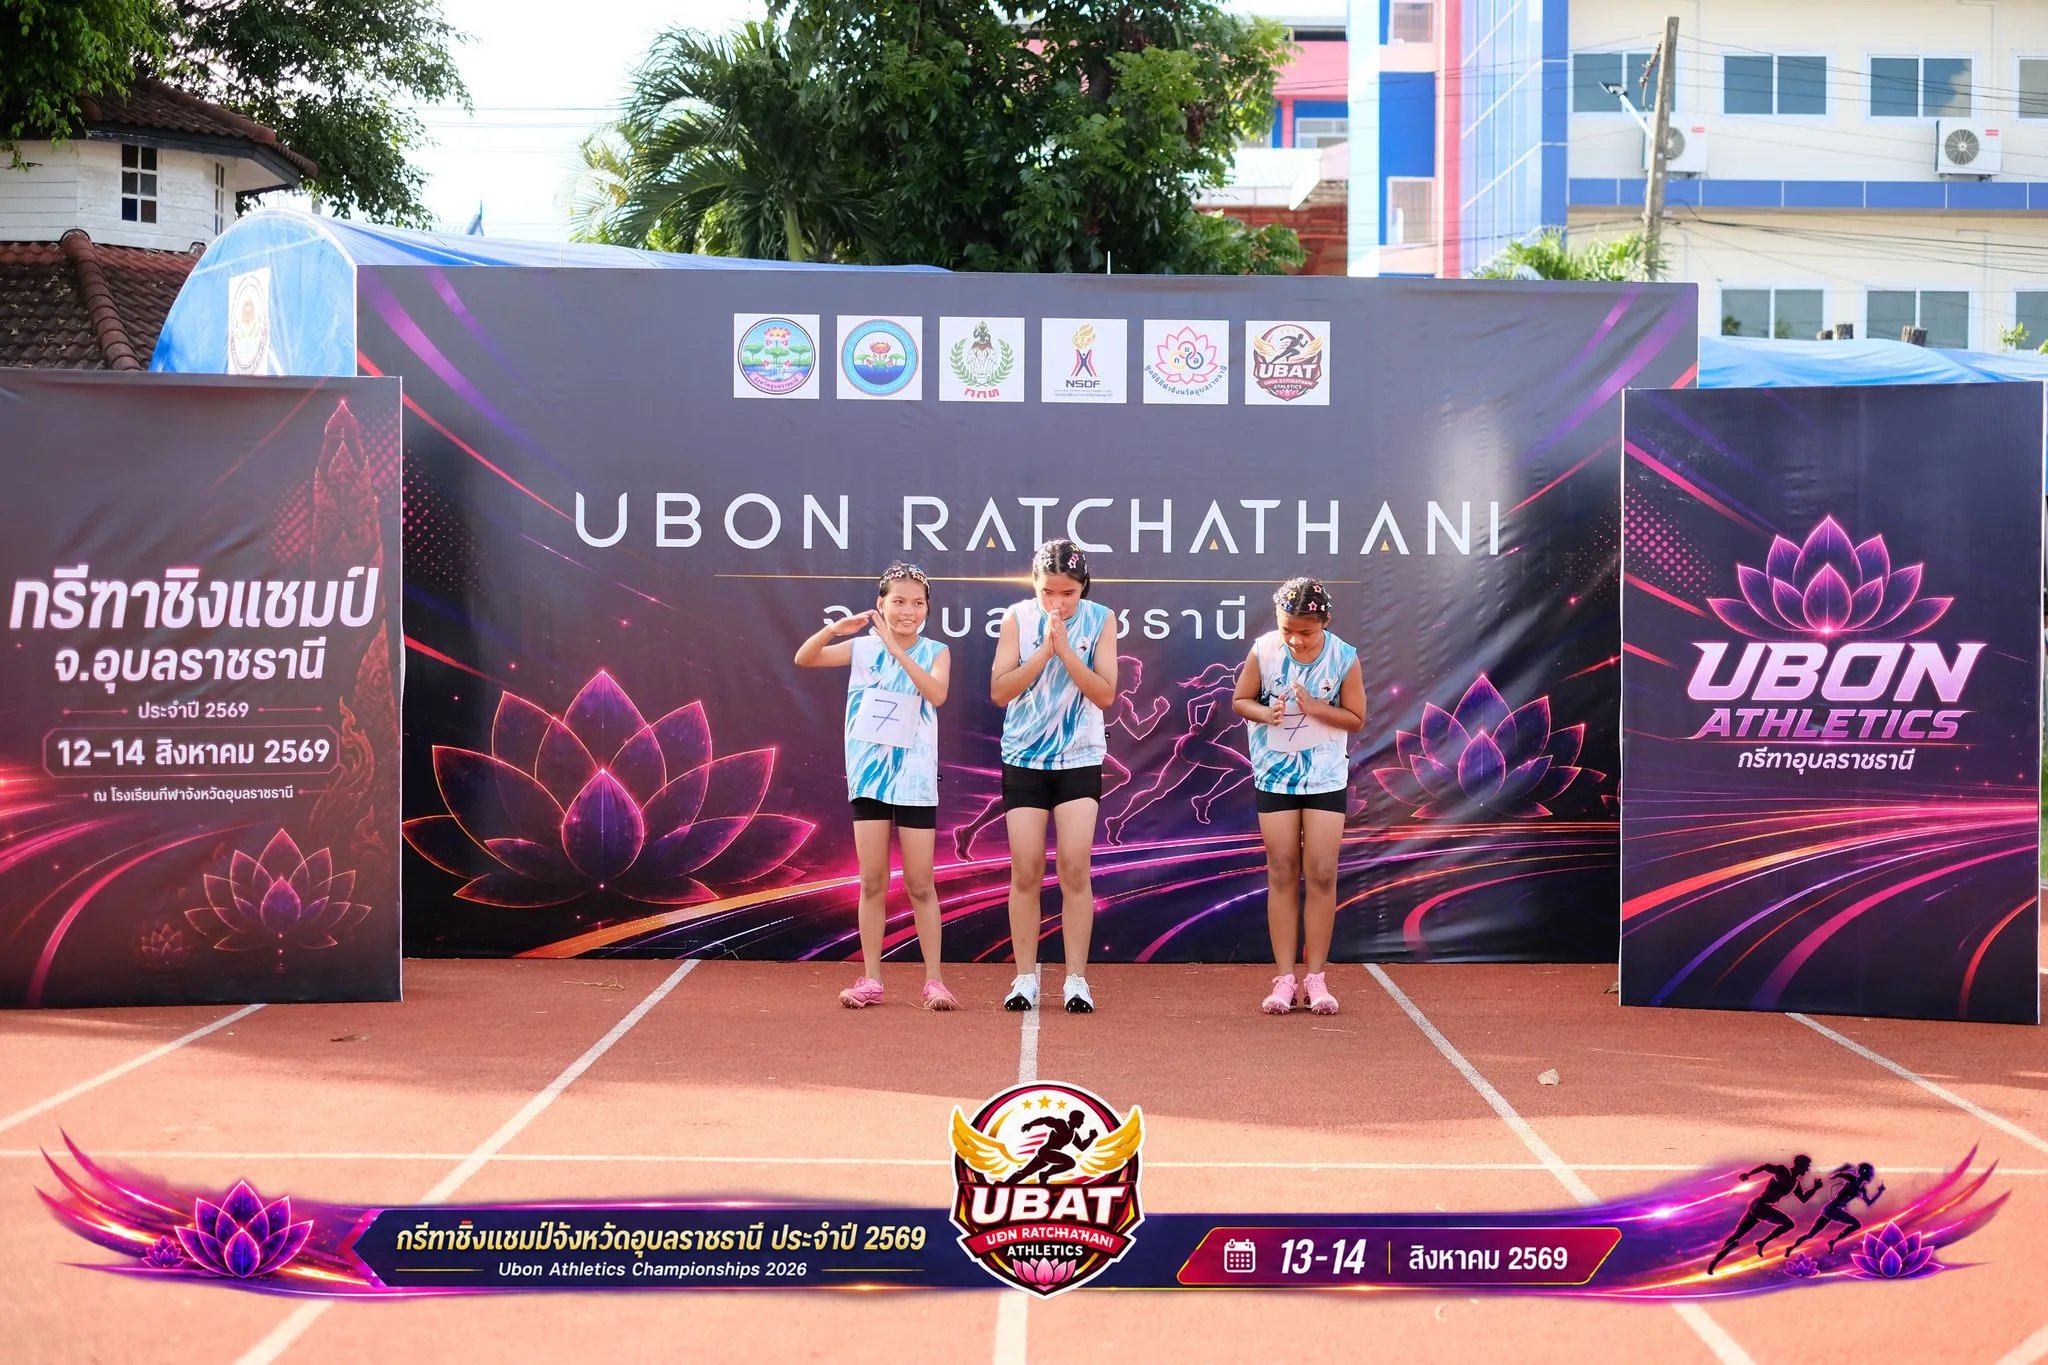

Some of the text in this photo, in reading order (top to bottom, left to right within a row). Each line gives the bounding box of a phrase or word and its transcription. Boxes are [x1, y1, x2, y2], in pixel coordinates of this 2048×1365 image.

[1065, 380, 1101, 388] NSDF
[1259, 363, 1316, 379] UBAT
[575, 491, 1499, 556] UBON RATCHATHANI
[9, 564, 380, 629] กรีฑาชิงแชมป์
[54, 636, 327, 694] จ.อุบลราชธานี
[1687, 642, 1988, 702] UBON
[138, 701, 250, 719] ประจำปี 2569
[872, 698, 901, 732] 7
[1686, 708, 1974, 739] ATHLETICS
[1282, 712, 1310, 742] 7
[155, 738, 254, 765] สิงหาคม
[263, 739, 331, 764] 2569
[1737, 746, 1917, 776] กรีฑาอุบลราชธานี
[93, 785, 294, 804] ณ โรงเรียนกีฬาจังหวัดอุบลราชธานี
